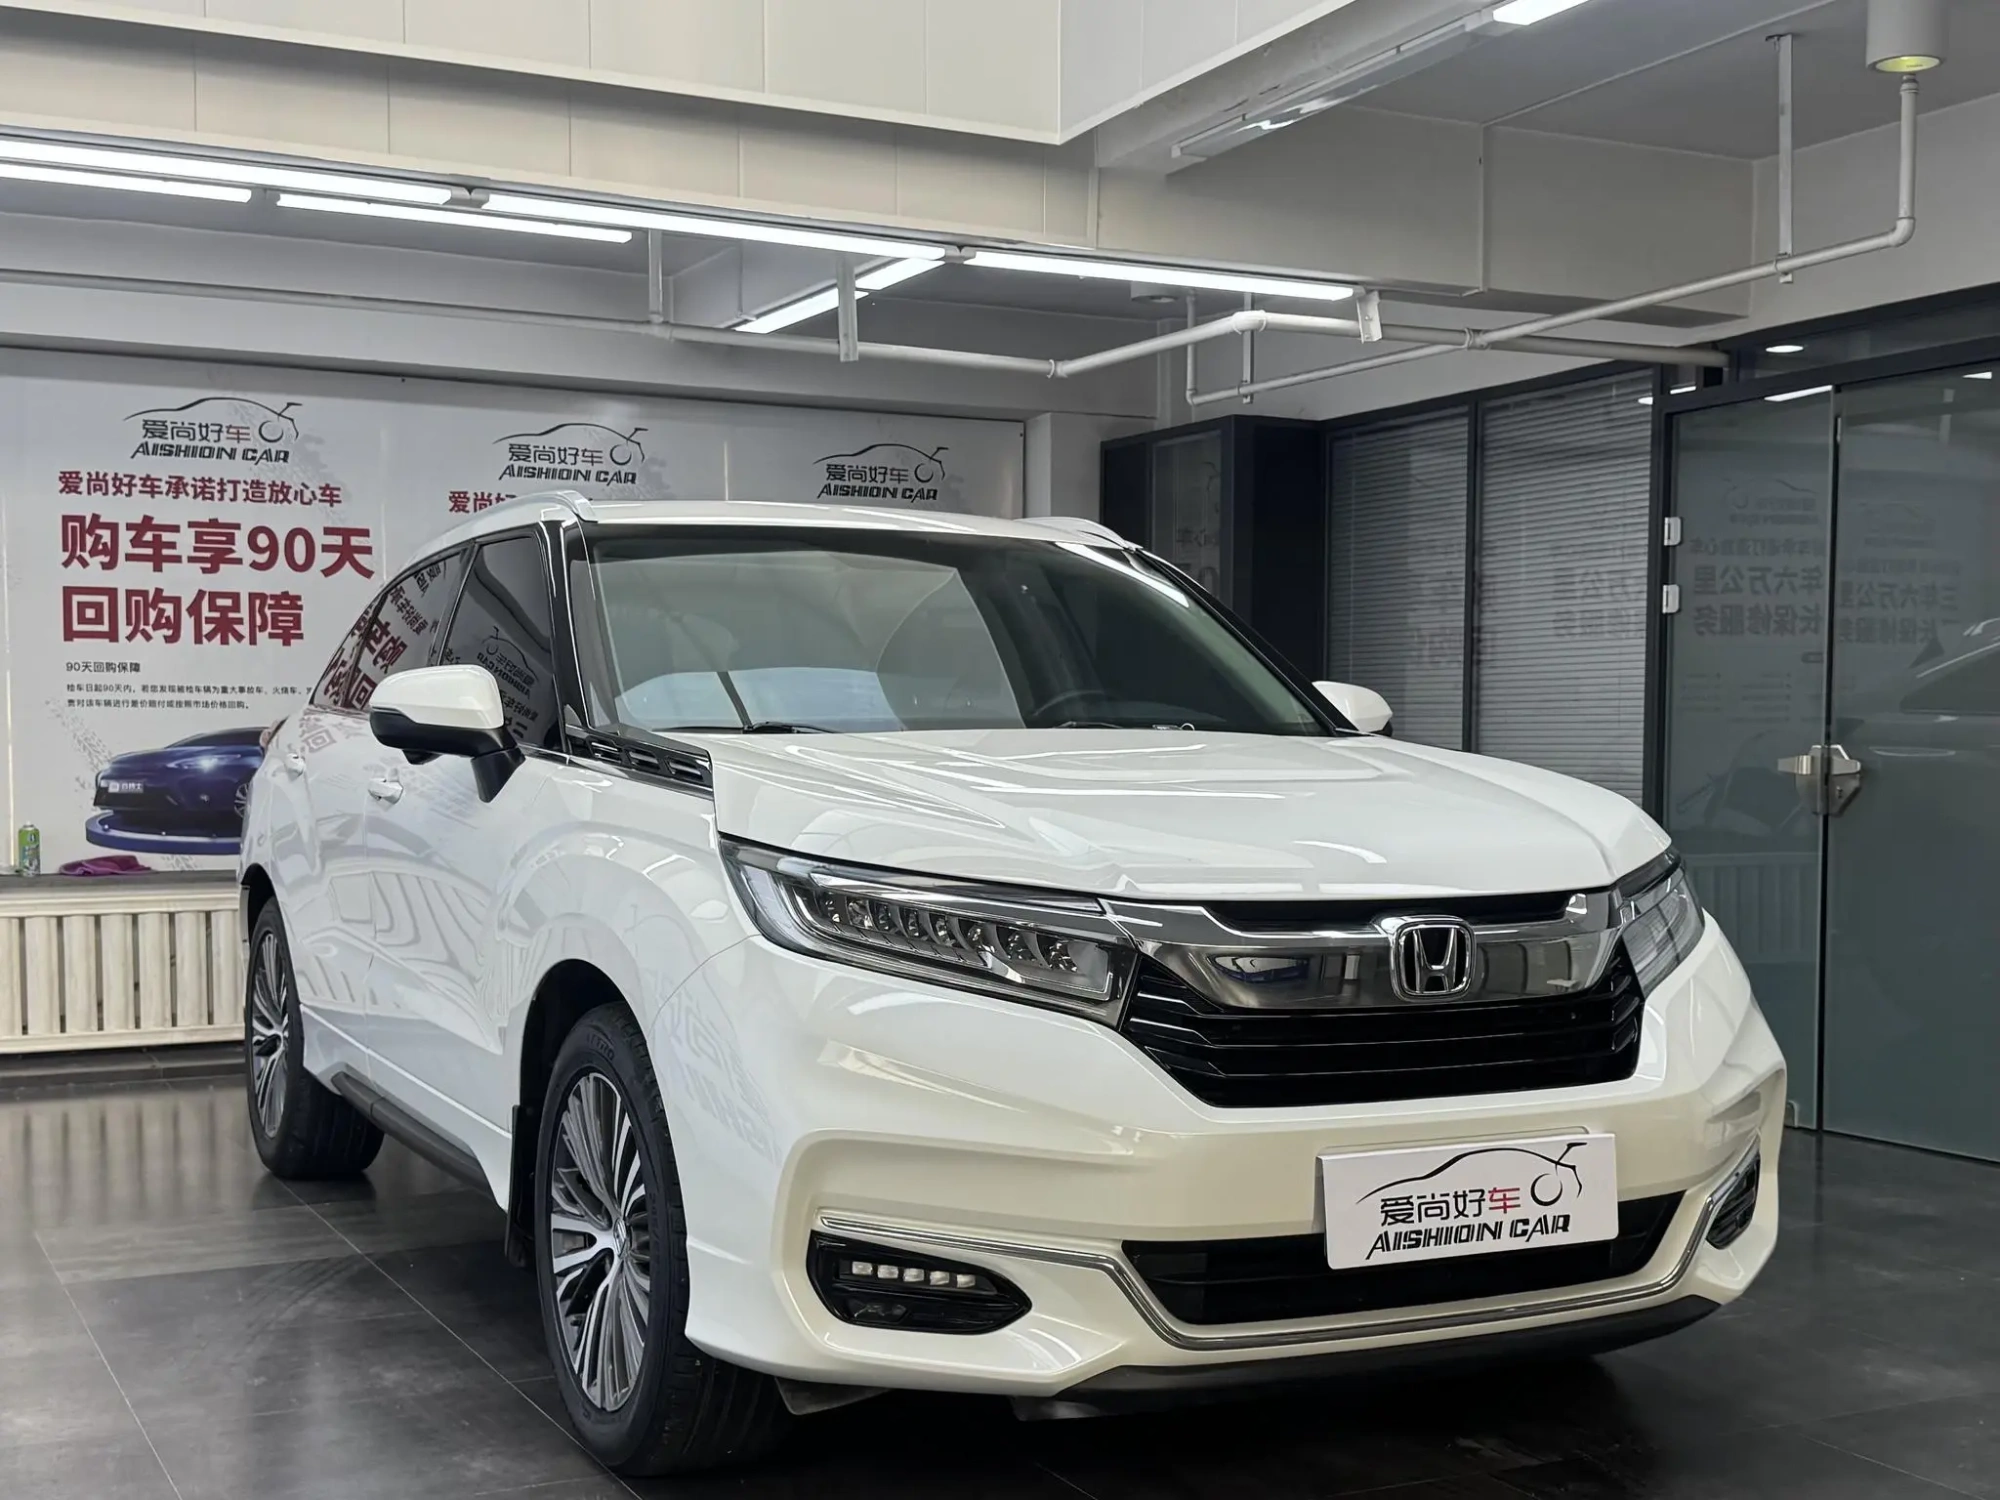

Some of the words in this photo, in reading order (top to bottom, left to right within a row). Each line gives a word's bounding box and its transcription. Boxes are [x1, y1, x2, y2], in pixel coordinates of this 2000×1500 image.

[141, 419, 251, 444] 爱尚好车
[130, 441, 239, 461] AISHION
[241, 446, 290, 465] CAR
[508, 443, 604, 467] 爱尚好车
[498, 463, 591, 483] AISHION
[594, 468, 637, 487] CAR
[825, 463, 910, 485] 爱尚好车
[58, 470, 343, 508] 爱尚好车承诺打造放心车
[817, 481, 899, 499] AISHION
[901, 486, 938, 504] CAR
[61, 513, 375, 580] 购车享90天
[62, 585, 305, 647] 回购保障
[65, 661, 141, 673] 90天回购保障
[1380, 1186, 1521, 1227] 爱尚好车
[1365, 1220, 1503, 1260] AISHION
[1508, 1213, 1571, 1243] CAR
